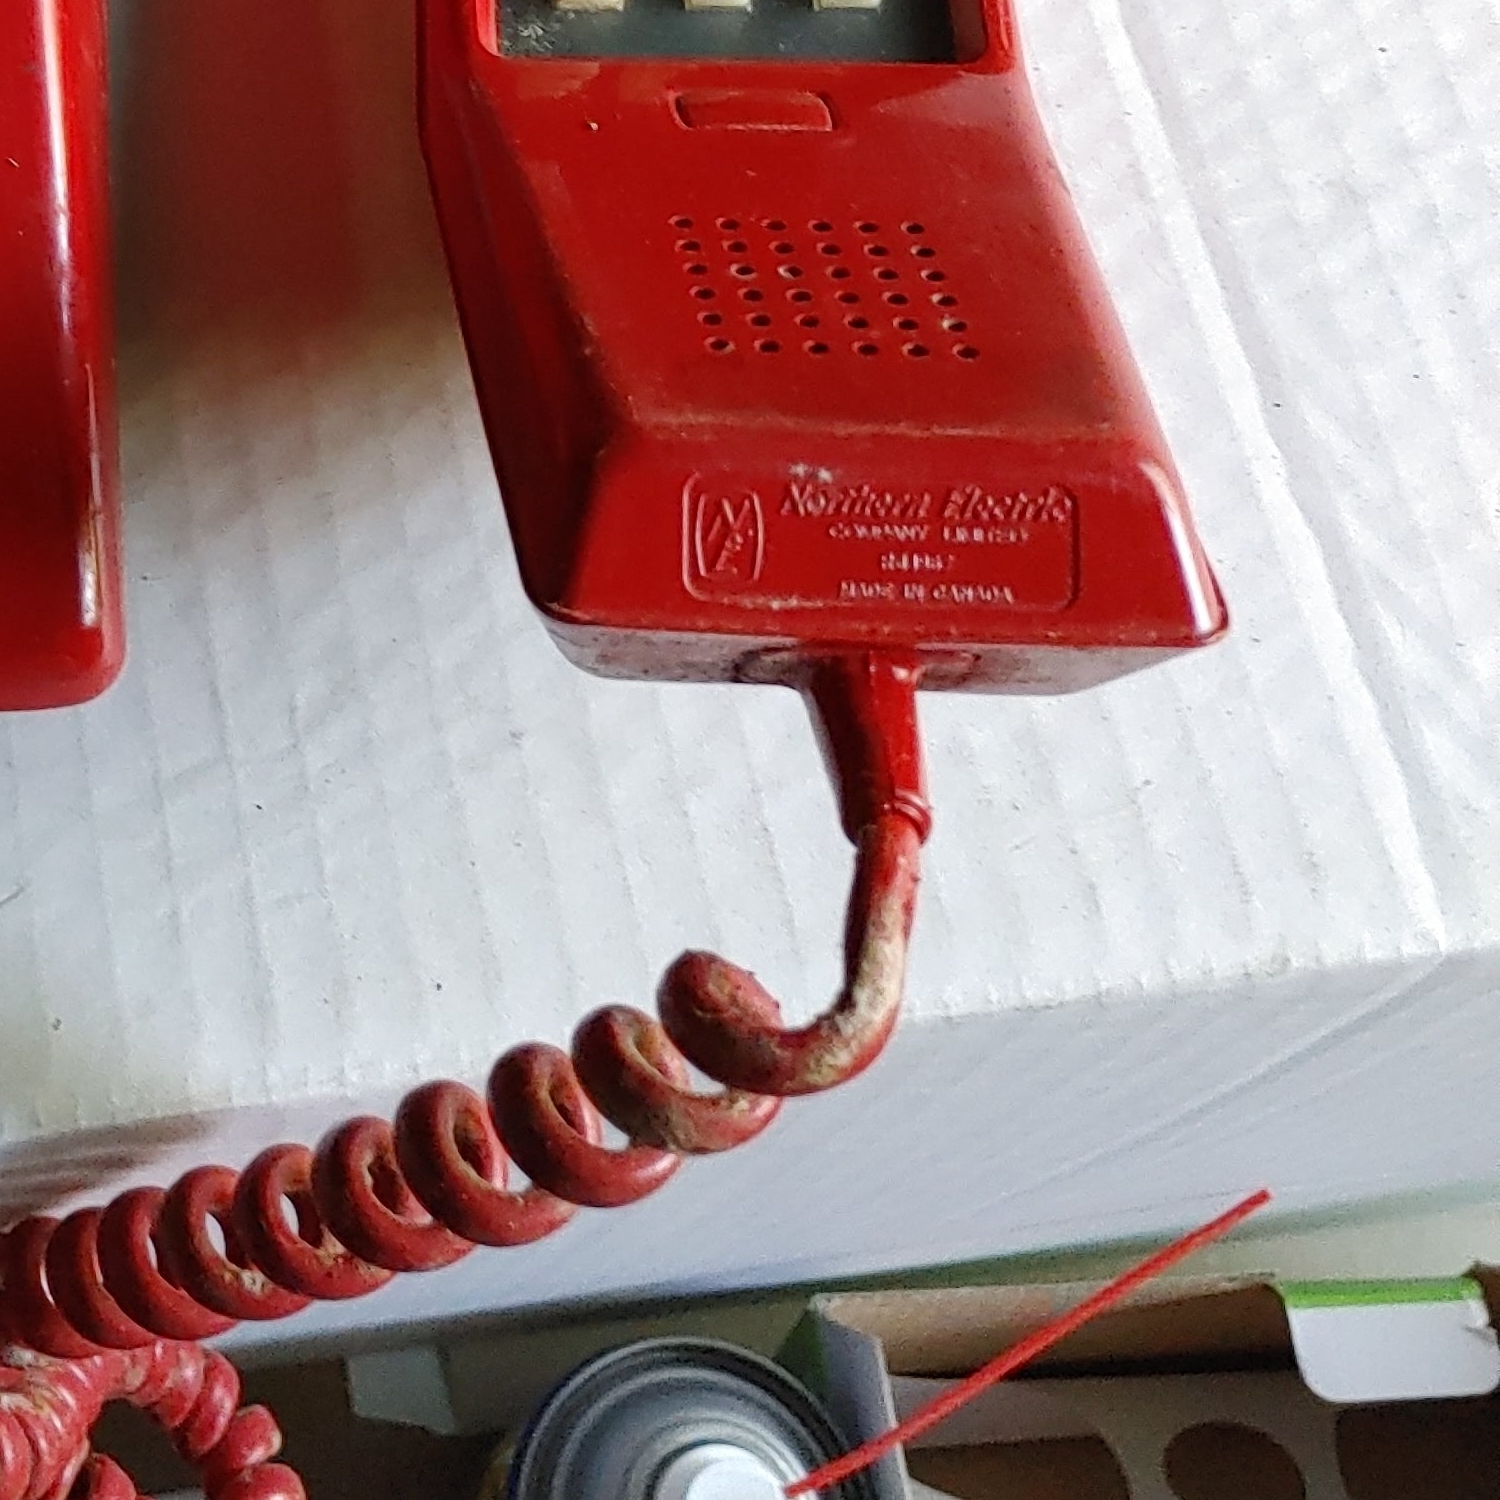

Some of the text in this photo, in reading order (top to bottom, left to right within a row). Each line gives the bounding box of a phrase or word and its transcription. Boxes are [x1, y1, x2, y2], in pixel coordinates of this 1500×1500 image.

[837, 579, 1016, 606] MADE IN CANADA
